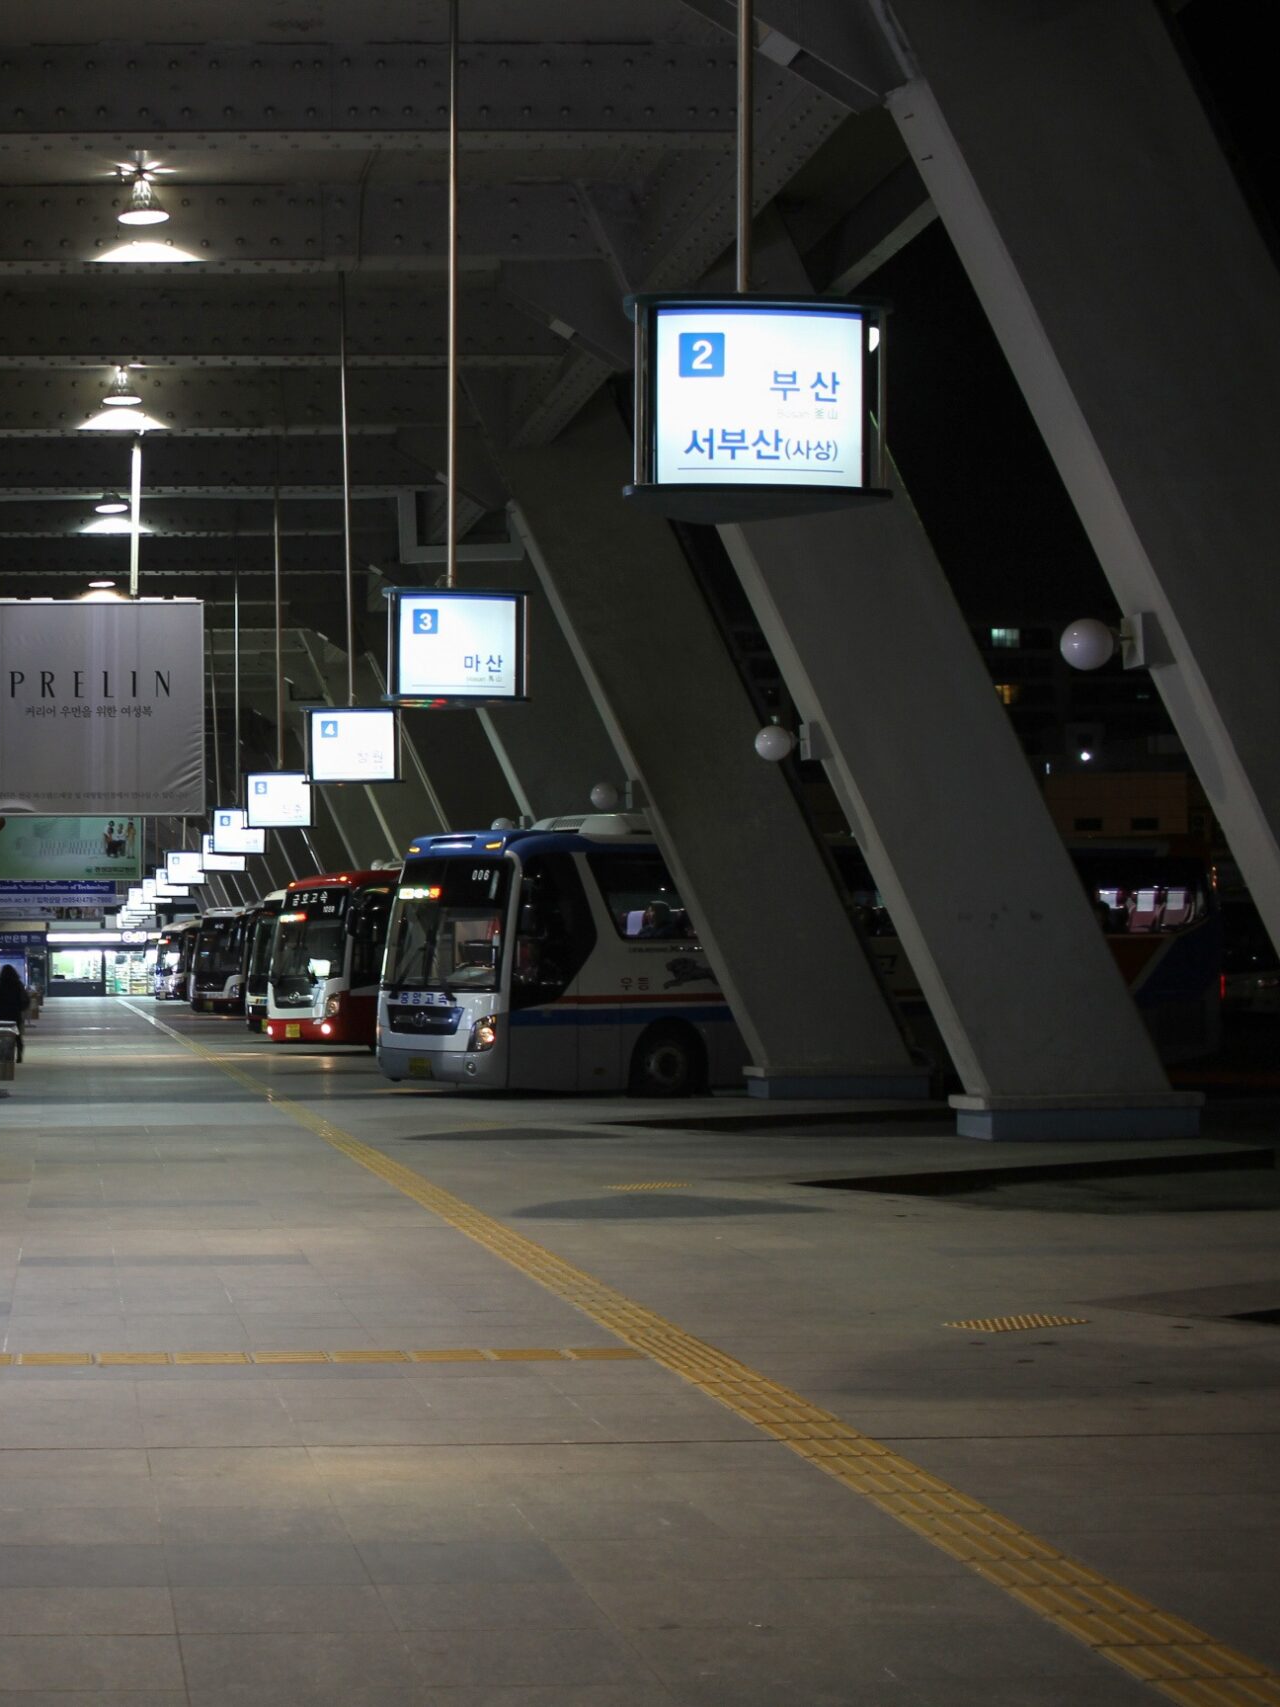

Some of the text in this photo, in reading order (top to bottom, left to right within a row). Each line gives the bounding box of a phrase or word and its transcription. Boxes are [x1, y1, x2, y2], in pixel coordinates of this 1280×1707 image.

[691, 340, 713, 370] 2
[418, 613, 432, 631] 3
[8, 670, 170, 698] PRELIN
[25, 705, 153, 719] 커리어 우먼을 위한 여성복
[324, 723, 335, 736] 4
